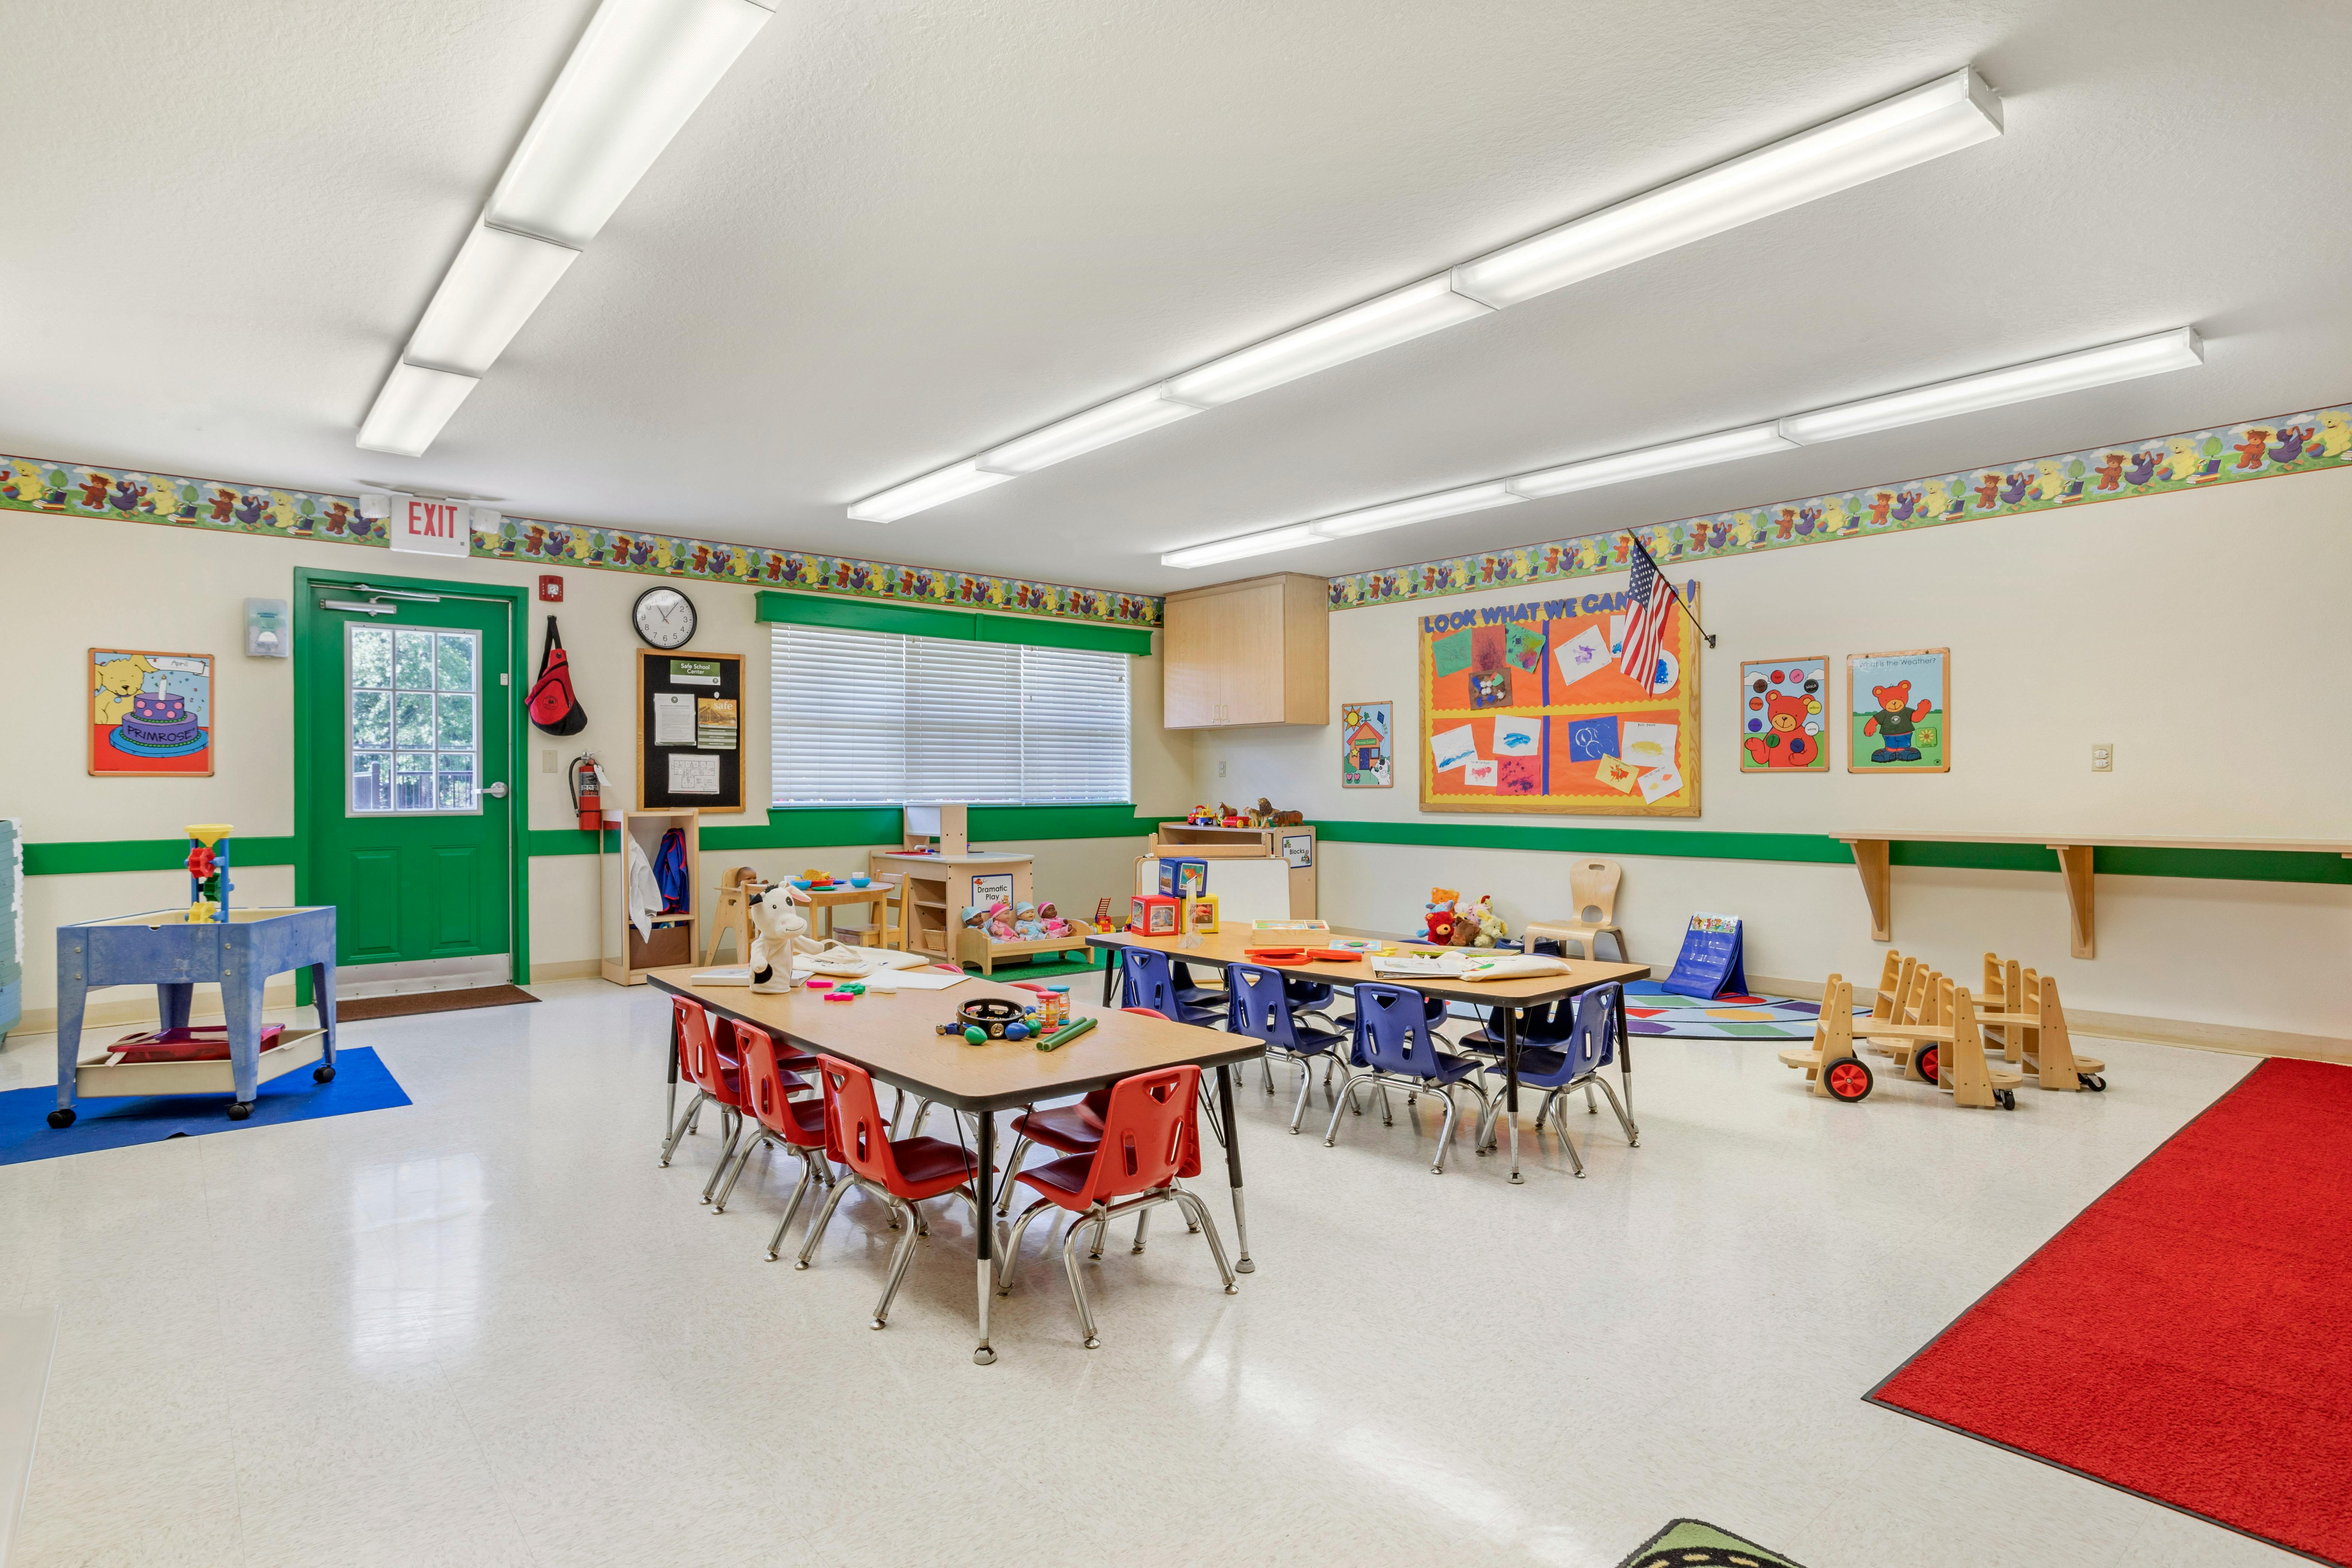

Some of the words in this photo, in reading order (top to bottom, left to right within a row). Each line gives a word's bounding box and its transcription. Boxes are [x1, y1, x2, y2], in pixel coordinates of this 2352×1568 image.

[409, 501, 458, 538] EXIT
[1424, 609, 1476, 633] LOOK
[1481, 602, 1540, 625] WHAT
[1544, 598, 1577, 620] WE
[1581, 591, 1629, 614] CAN
[714, 701, 733, 710] safe
